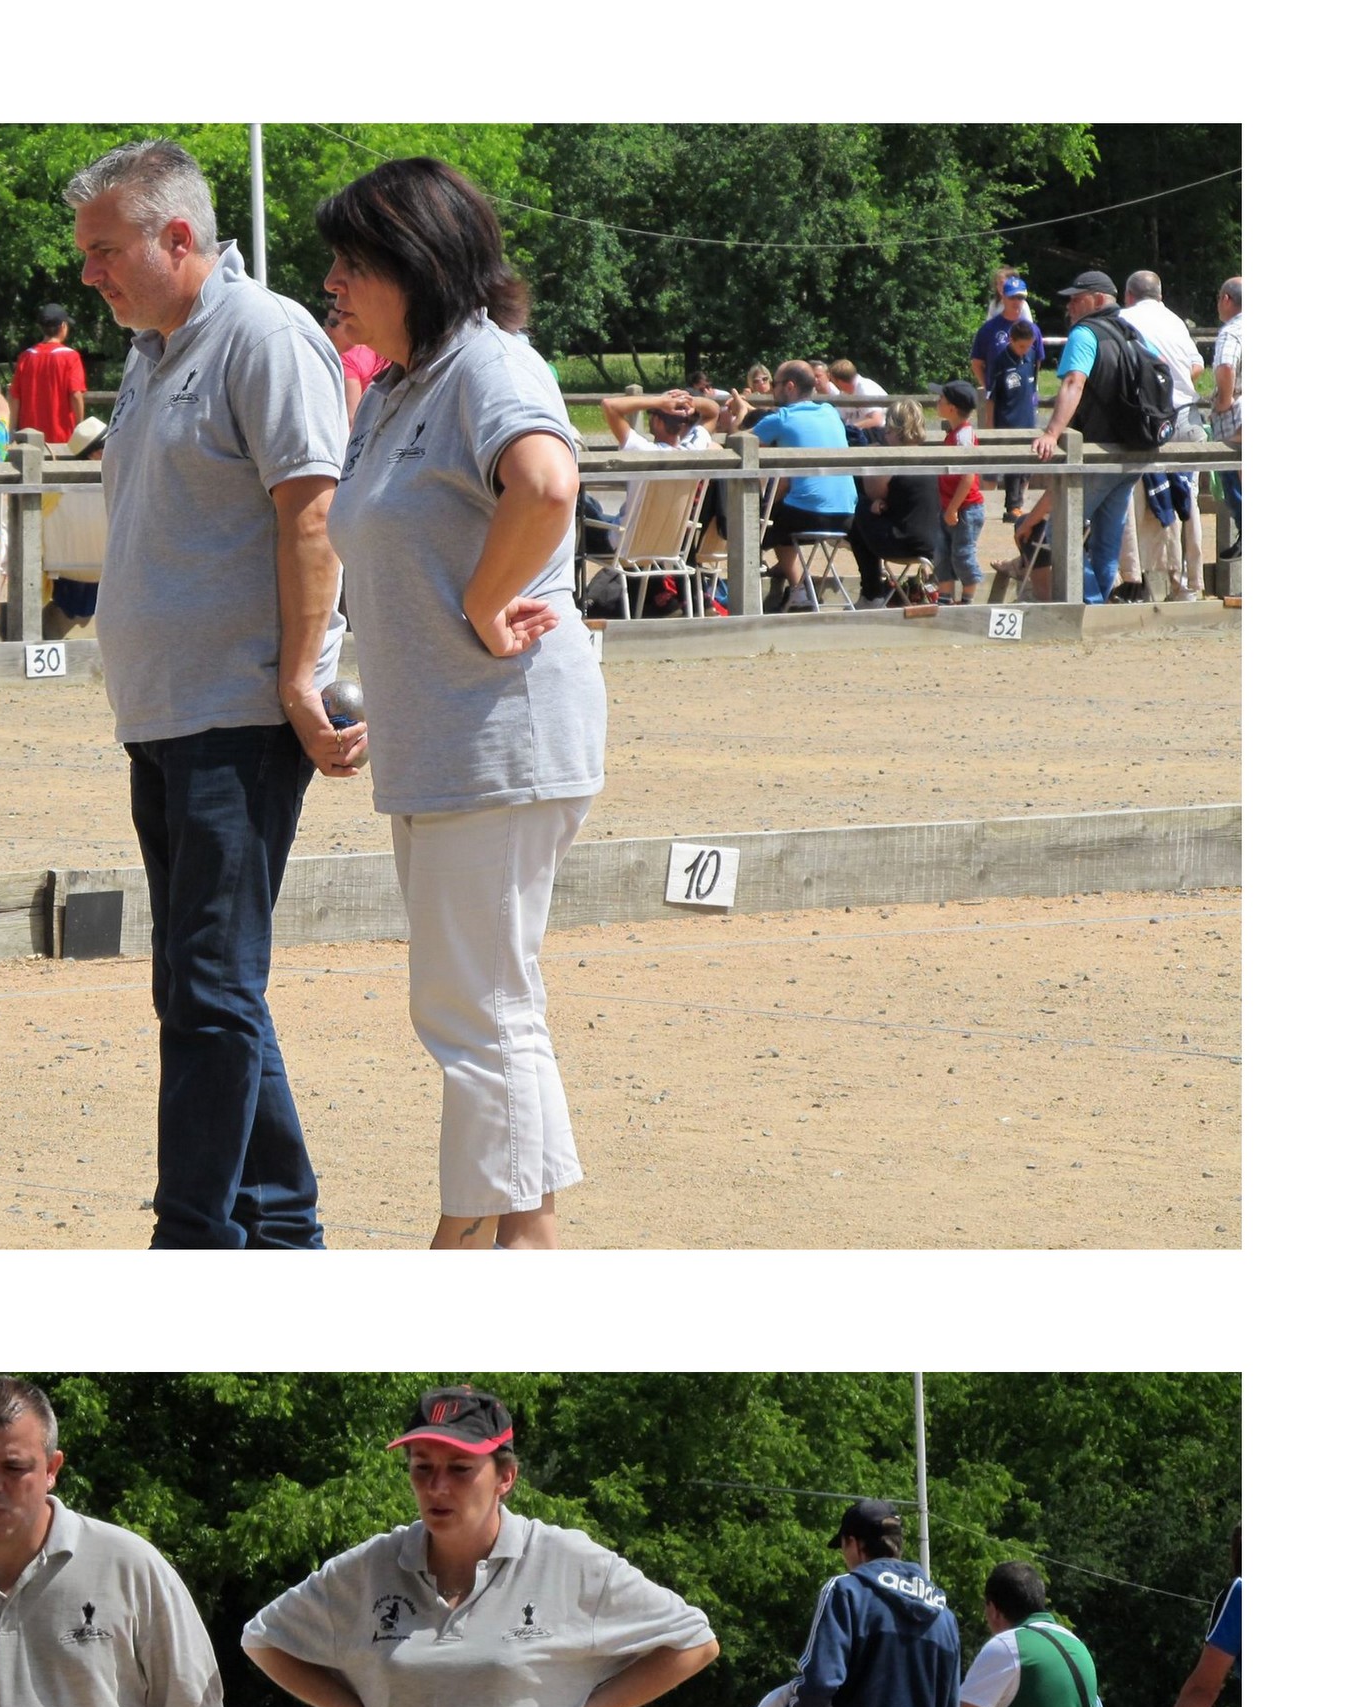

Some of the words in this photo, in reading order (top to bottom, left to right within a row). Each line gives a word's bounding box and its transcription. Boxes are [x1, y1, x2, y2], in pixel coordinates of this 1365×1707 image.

[994, 612, 1018, 637] 32
[33, 646, 61, 674] 30
[684, 849, 722, 901] 10
